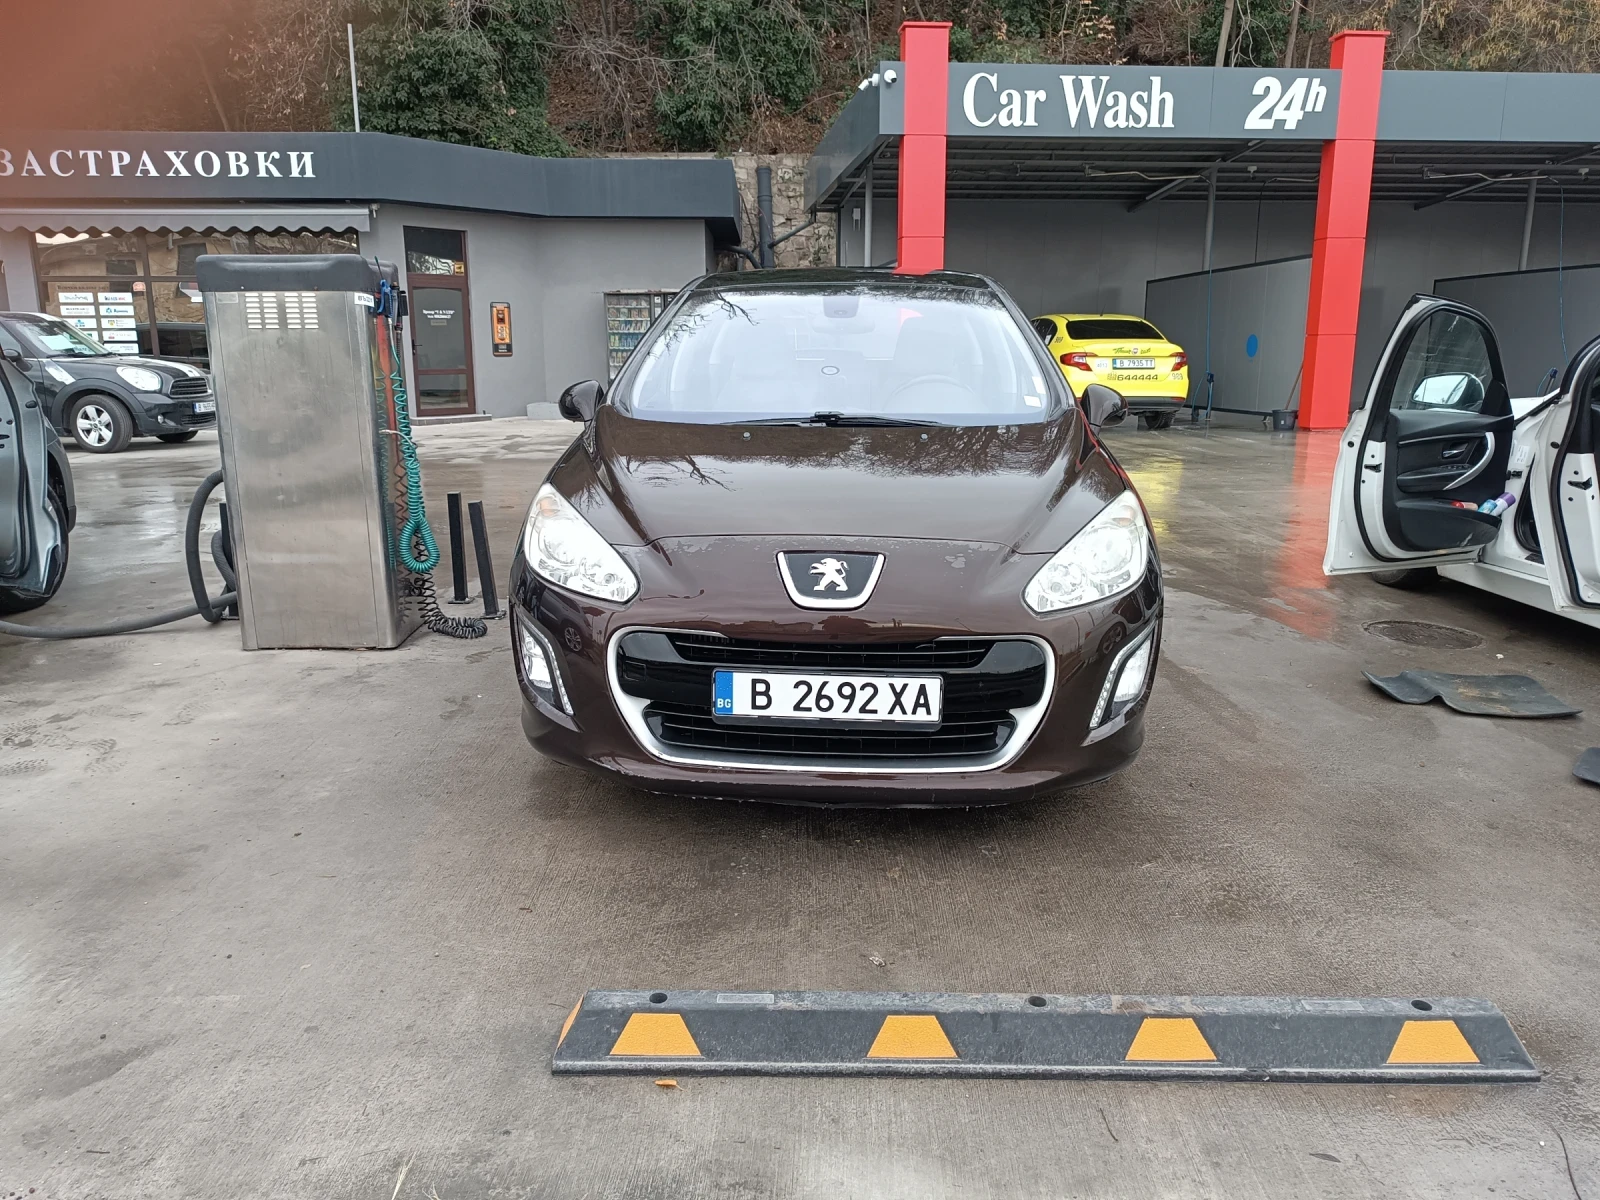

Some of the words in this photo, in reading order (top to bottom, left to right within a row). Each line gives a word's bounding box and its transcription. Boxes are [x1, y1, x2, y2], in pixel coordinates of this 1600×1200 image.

[963, 72, 1047, 128] Car
[1060, 75, 1175, 129] Wash
[1243, 76, 1328, 130] 24h
[0, 149, 317, 178] ЗАСТРАХОВКИ
[1127, 359, 1144, 367] 7935
[1145, 359, 1154, 367] TT
[716, 697, 732, 709] BG
[750, 678, 773, 711] B
[792, 679, 880, 715] 2692
[887, 682, 933, 716] XA
